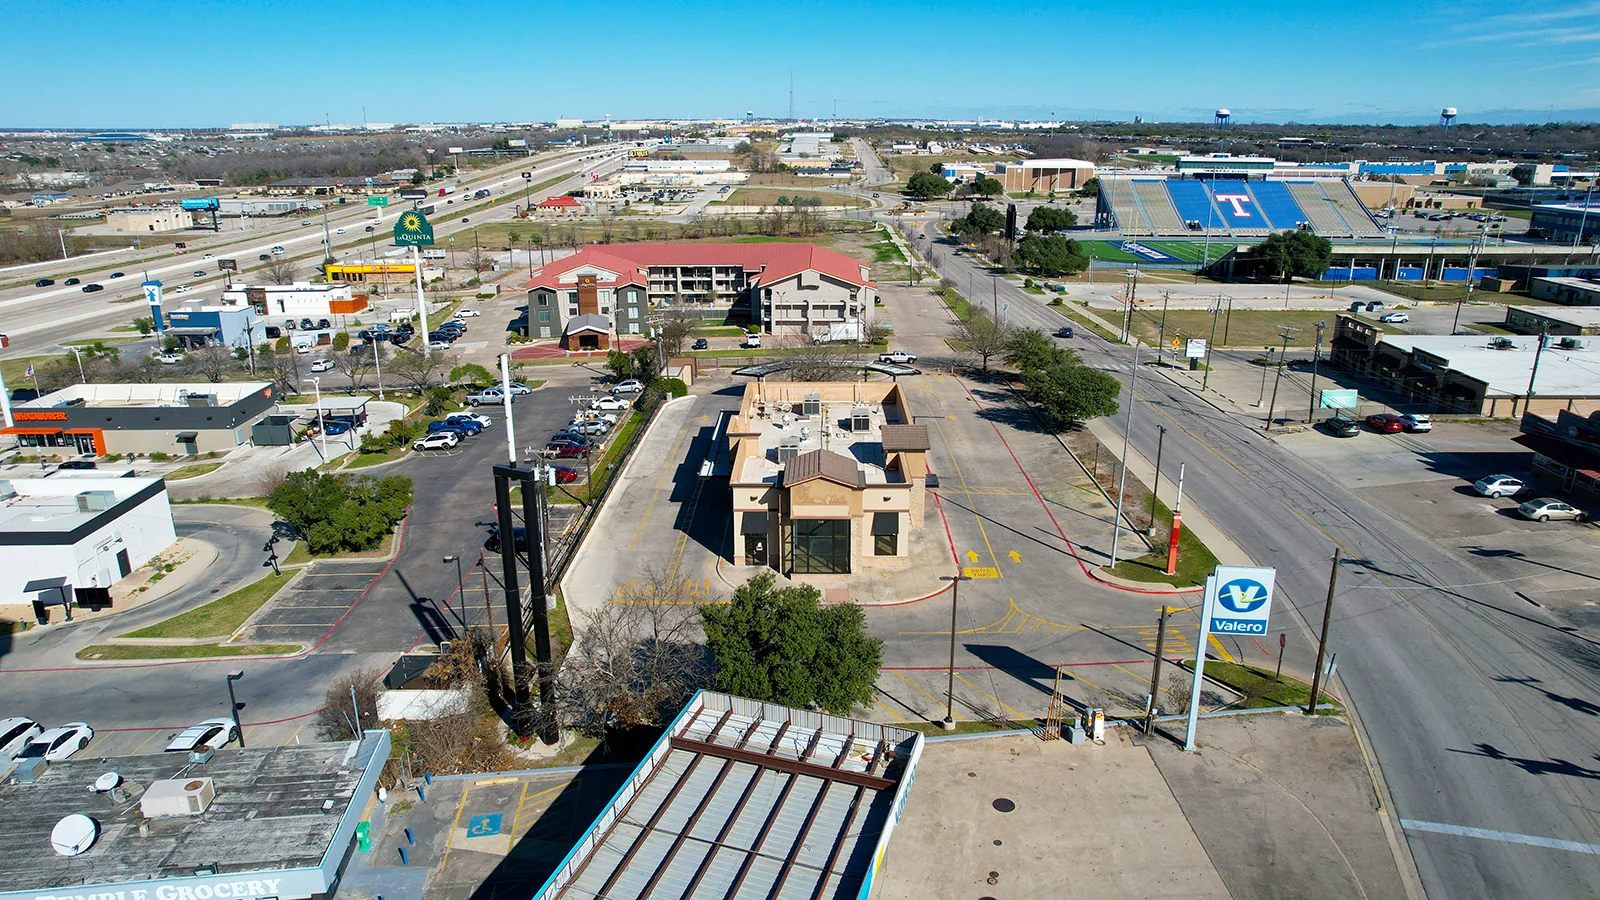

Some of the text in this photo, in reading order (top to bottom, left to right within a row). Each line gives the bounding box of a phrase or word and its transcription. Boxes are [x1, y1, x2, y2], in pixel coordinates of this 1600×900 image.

[1215, 194, 1252, 217] T
[1215, 620, 1263, 632] Valero
[155, 879, 282, 900] GROCERY
